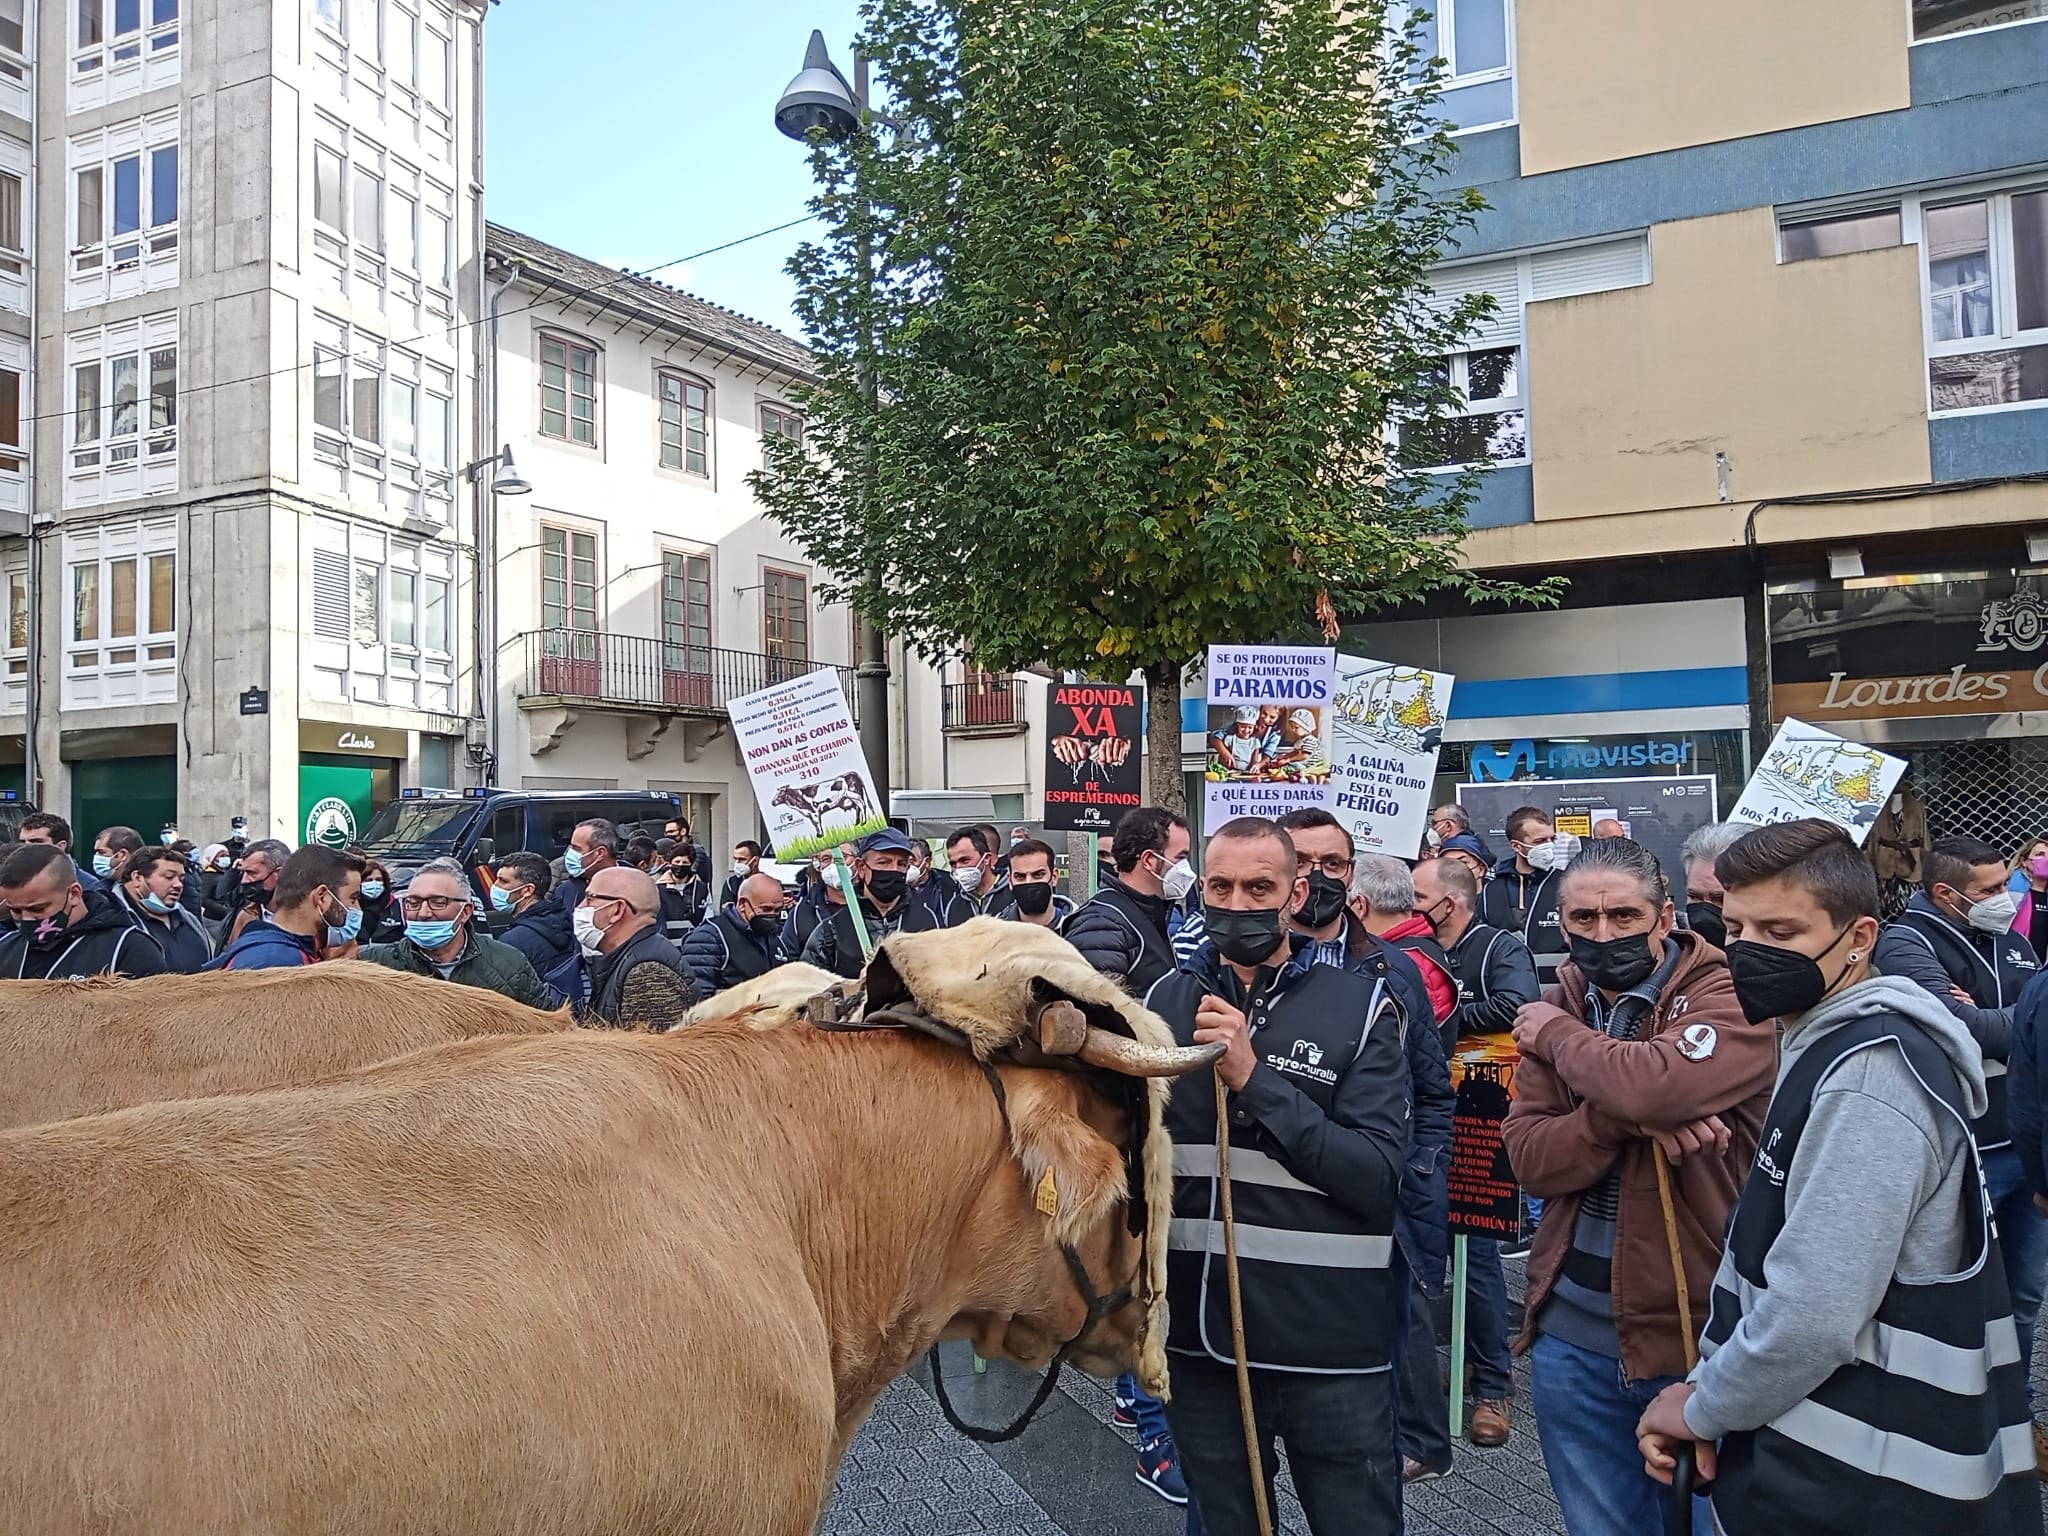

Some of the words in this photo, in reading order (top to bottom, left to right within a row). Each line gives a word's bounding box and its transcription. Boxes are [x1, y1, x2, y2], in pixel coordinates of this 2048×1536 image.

[1216, 653, 1231, 664] SE
[1234, 654, 1249, 664] OS
[1252, 654, 1326, 666] PRODUTORES
[1232, 666, 1247, 676] DE
[1250, 667, 1310, 677] ALIMENTOS
[1214, 678, 1327, 700] PARAMOS
[1819, 664, 2011, 709] Lourdes
[1054, 688, 1134, 706] ABONDA
[1070, 706, 1117, 737] XA
[338, 732, 375, 749] Clarks
[747, 745, 770, 760] NON
[771, 737, 793, 752] DAN
[795, 732, 808, 745] AS
[809, 719, 848, 739] CONTAS
[754, 757, 791, 775] GRANXAS
[792, 750, 810, 762] QUE
[810, 735, 854, 756] PECHARON
[1549, 740, 1693, 769] movistar
[783, 761, 809, 774] GALICIA
[1347, 753, 1356, 765] A
[1360, 755, 1404, 774] GALIÑA
[799, 766, 820, 780] 310
[1330, 764, 1344, 775] OS
[1346, 767, 1375, 781] OVOS
[1378, 772, 1393, 784] DE
[1395, 776, 1426, 790] OURO
[1085, 781, 1100, 791] DE
[1222, 786, 1247, 802] QUÉ
[1250, 789, 1280, 801] LLES
[1283, 787, 1324, 801] DARÁS
[1349, 781, 1375, 795] ESTÁ
[1378, 787, 1393, 798] EN
[1046, 790, 1140, 805] ESPREMERNOS
[1336, 792, 1400, 816] PERIGO
[1230, 804, 1247, 816] DE
[1250, 805, 1293, 816] COMER
[1740, 806, 1764, 823] DOS
